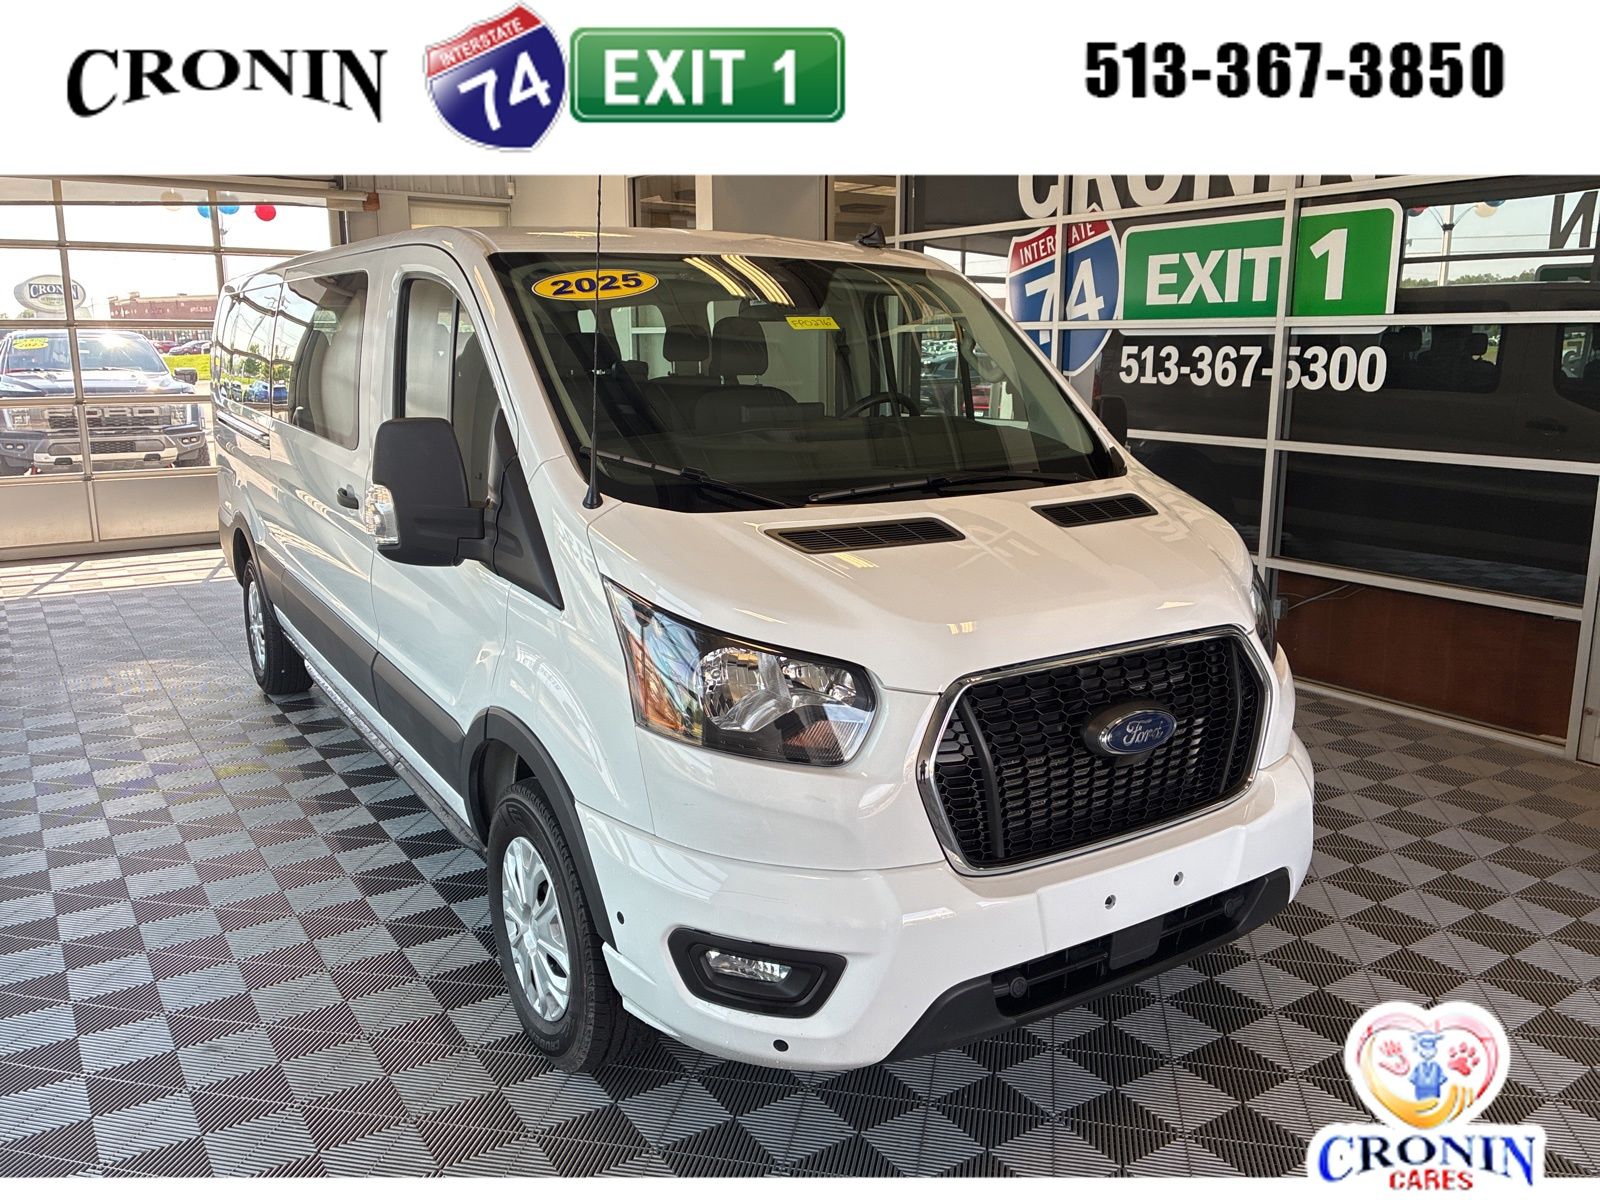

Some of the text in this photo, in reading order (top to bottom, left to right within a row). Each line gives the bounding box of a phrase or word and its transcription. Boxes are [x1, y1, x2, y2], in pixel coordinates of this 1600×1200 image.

[1018, 175, 1378, 219] CRO
[1019, 221, 1096, 266] INTERATE
[550, 272, 643, 296] 2025
[1146, 228, 1349, 306] EXIT 1
[30, 284, 78, 299] CRONN
[1024, 257, 1105, 346] 74
[1118, 345, 1388, 393] 513-367-5300
[1123, 719, 1165, 746] Ford
